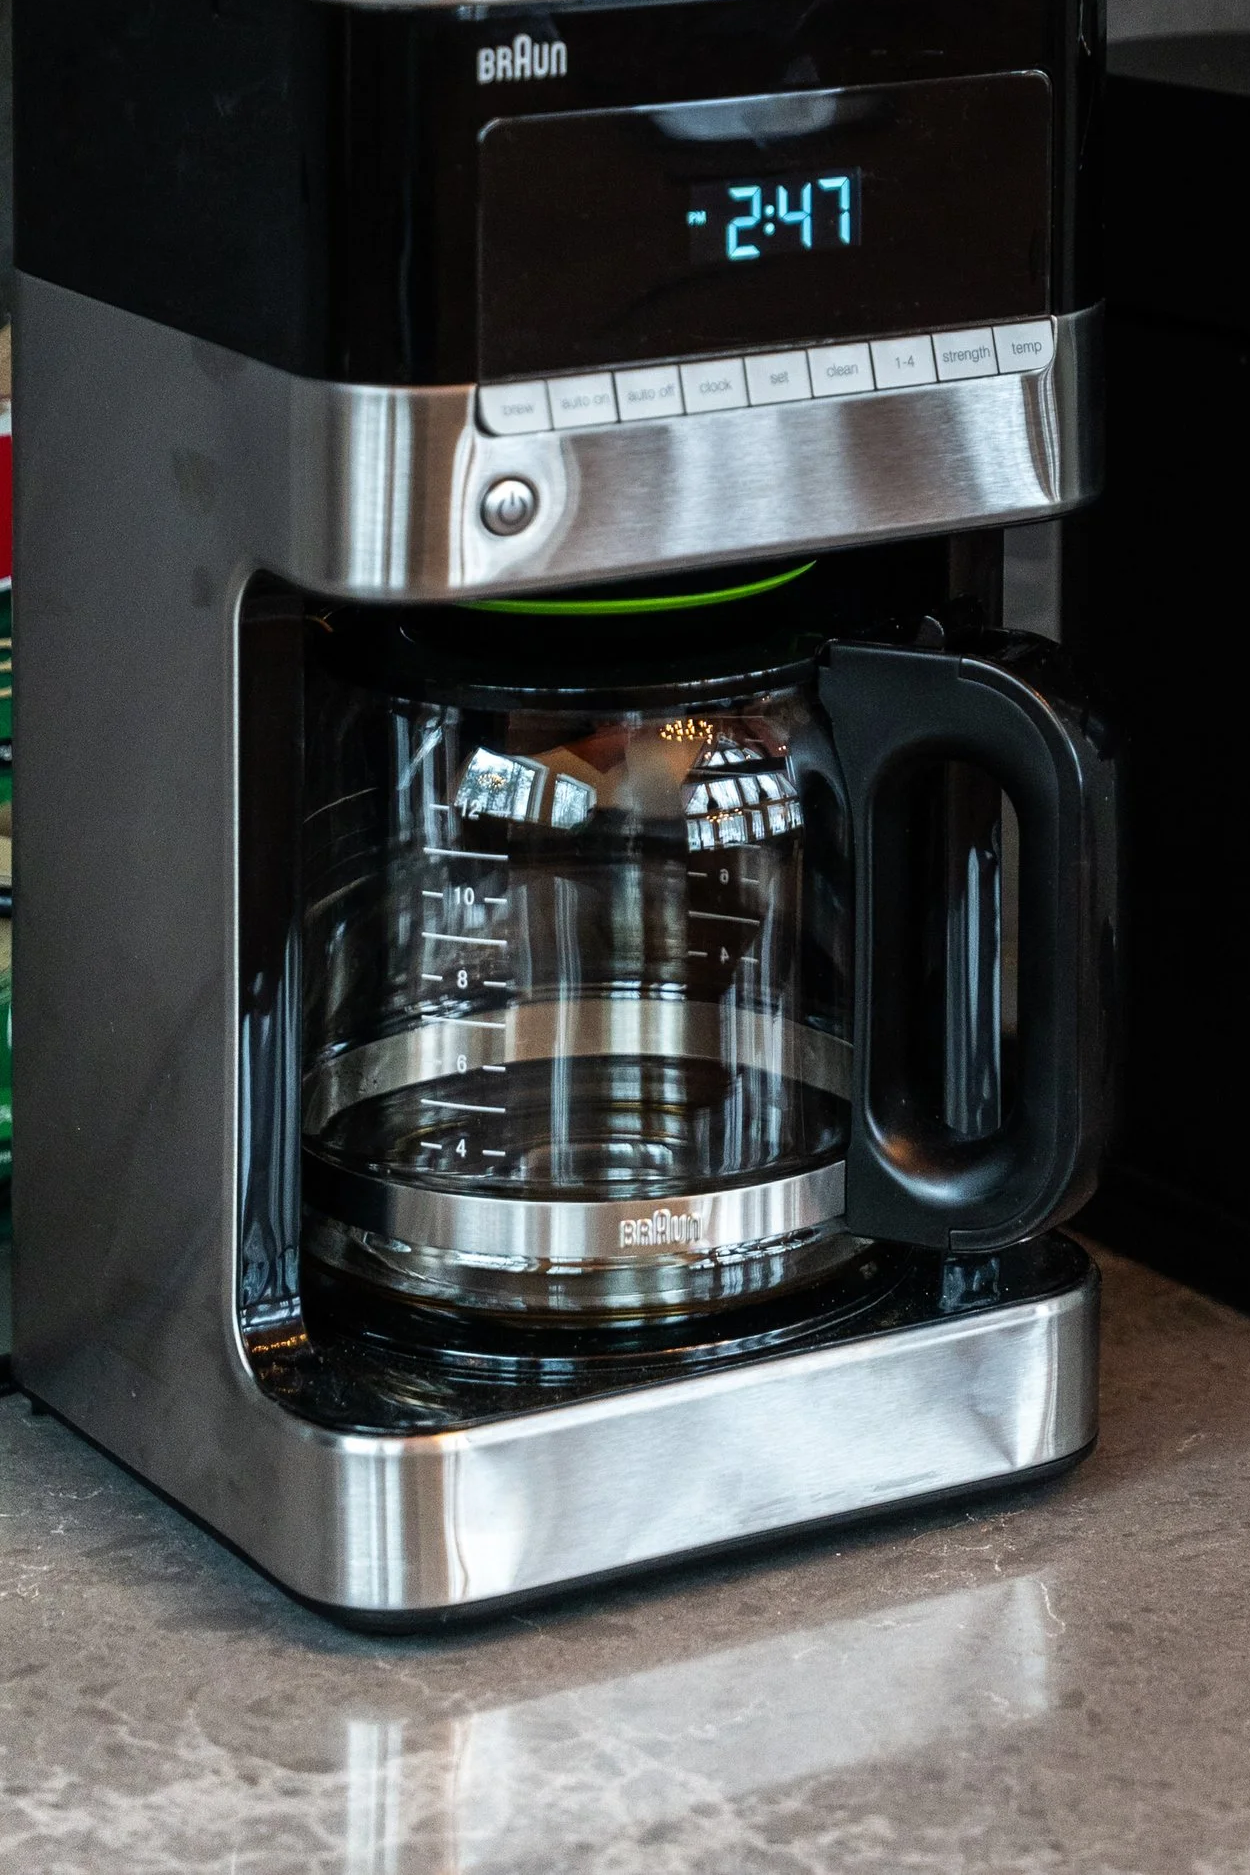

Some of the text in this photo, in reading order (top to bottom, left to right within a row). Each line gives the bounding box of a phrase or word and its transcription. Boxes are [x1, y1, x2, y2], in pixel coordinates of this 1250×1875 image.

[477, 32, 568, 84] BRAUN
[686, 177, 850, 261] PM 2:47
[942, 345, 991, 363] strength
[1011, 340, 1042, 356] temp
[826, 363, 859, 378] clean
[895, 355, 915, 370] 1-4
[699, 379, 733, 394] clock
[769, 370, 789, 385] set
[560, 393, 610, 410] auto on
[627, 382, 677, 404] auto off
[502, 401, 536, 417] brew
[460, 799, 482, 820] 12
[454, 886, 475, 905] 10
[457, 970, 468, 989] 8
[456, 1055, 468, 1073] 6
[455, 1138, 467, 1157] 4
[620, 1208, 702, 1248] BRAUN
